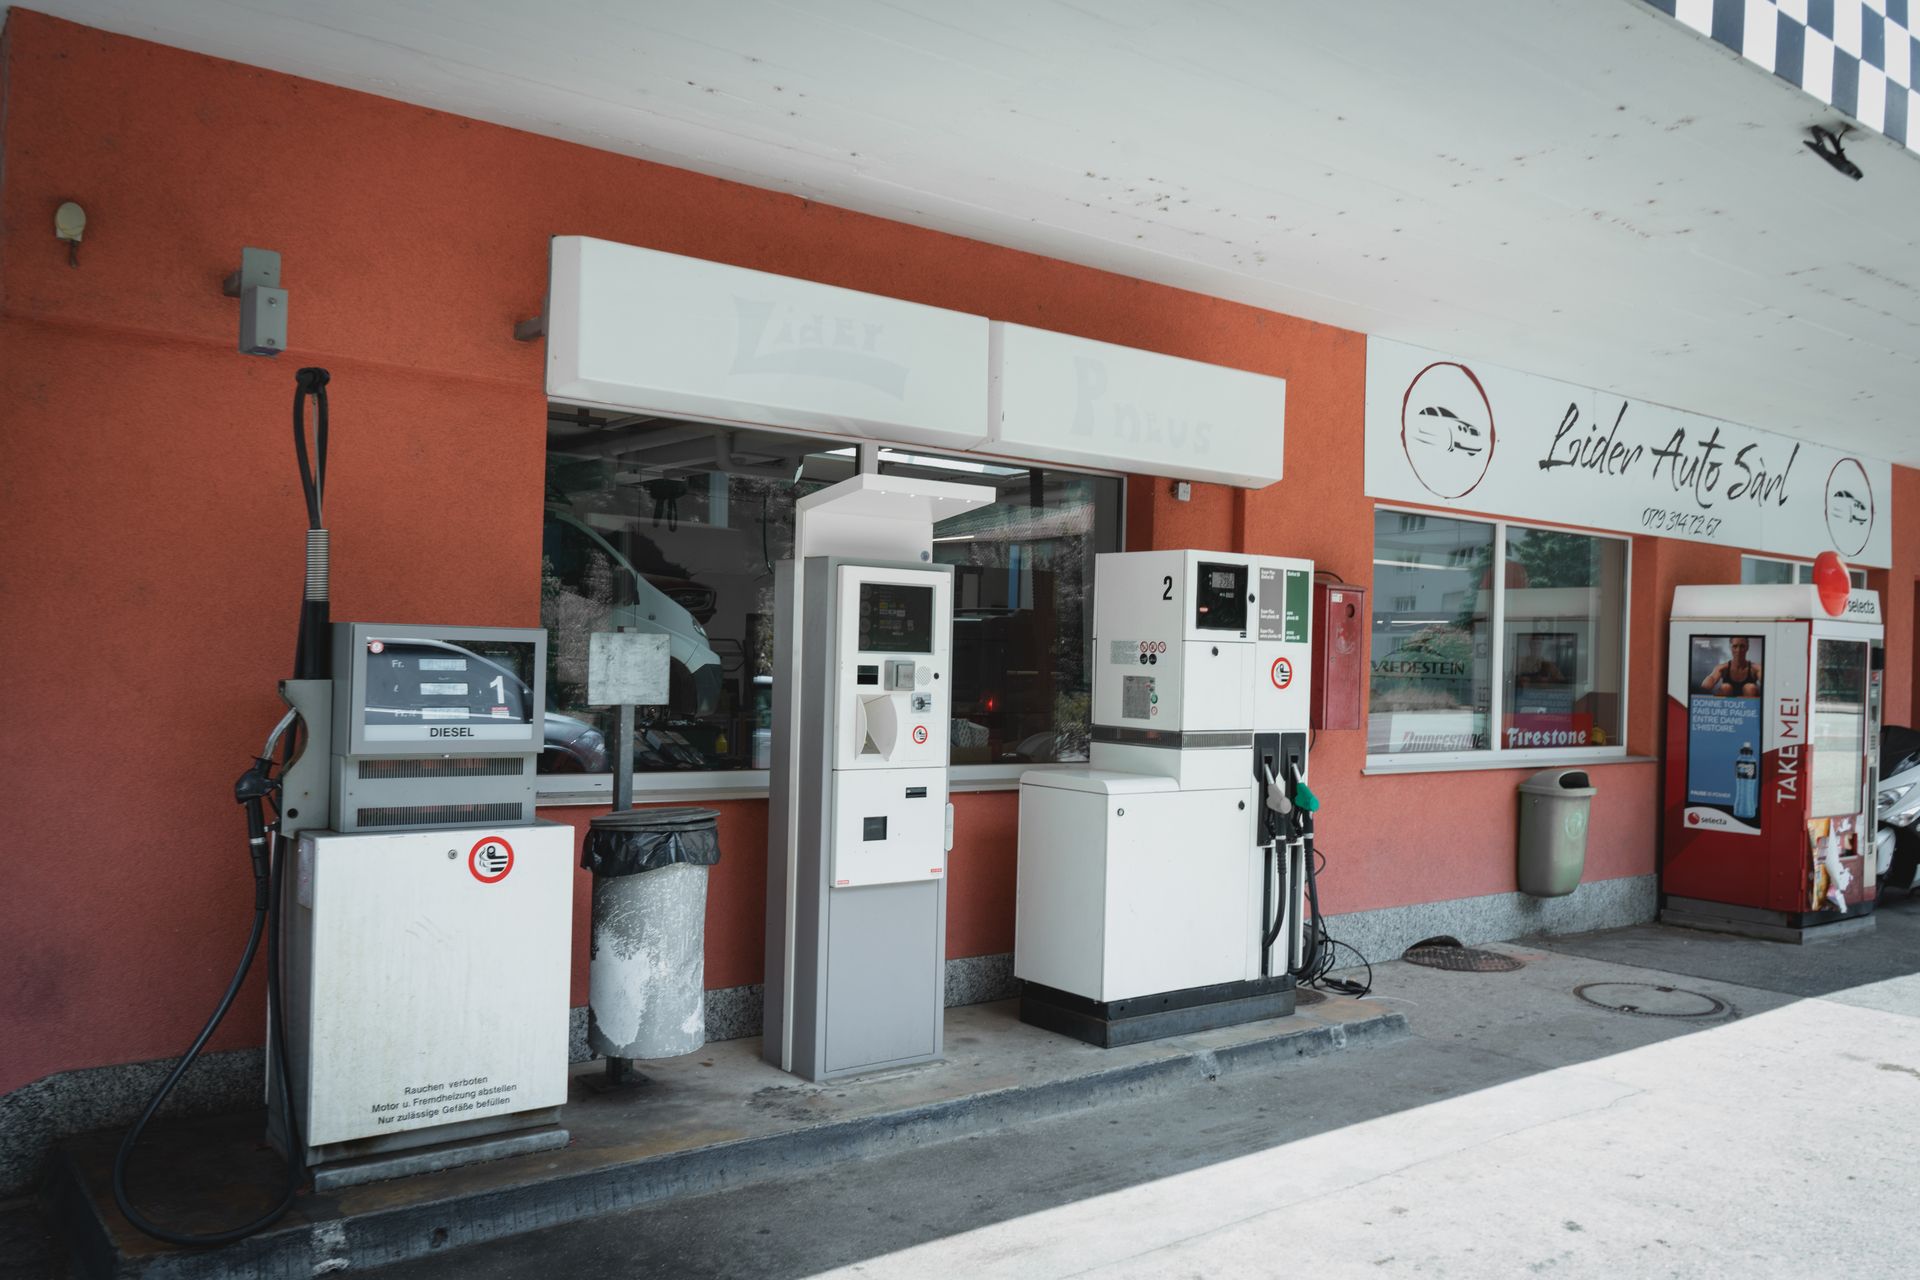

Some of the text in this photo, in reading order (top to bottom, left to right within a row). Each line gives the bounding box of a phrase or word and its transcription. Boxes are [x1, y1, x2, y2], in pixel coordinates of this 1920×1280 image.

[1539, 401, 1800, 509] Lider Auto Sàrl
[1163, 576, 1172, 600] 2
[1848, 598, 1875, 614] selecta
[1371, 660, 1464, 675] VREDESTEIN
[489, 675, 505, 704] 1
[1693, 699, 1722, 708] DONNE
[1711, 708, 1728, 716] UNE
[1692, 715, 1743, 725] ENTRE DANS
[430, 728, 474, 737] DIESEL
[1507, 728, 1586, 748] Firestone
[1777, 698, 1799, 803] TAKE ME!
[1701, 817, 1727, 825] selecta
[404, 1076, 488, 1095] Rauchen verboten
[371, 1102, 400, 1113] Motor
[413, 1089, 476, 1107] Fremdheizung
[478, 1084, 517, 1096] abstellen
[378, 1097, 510, 1124] Nur zulässige Gefäße befüllen
